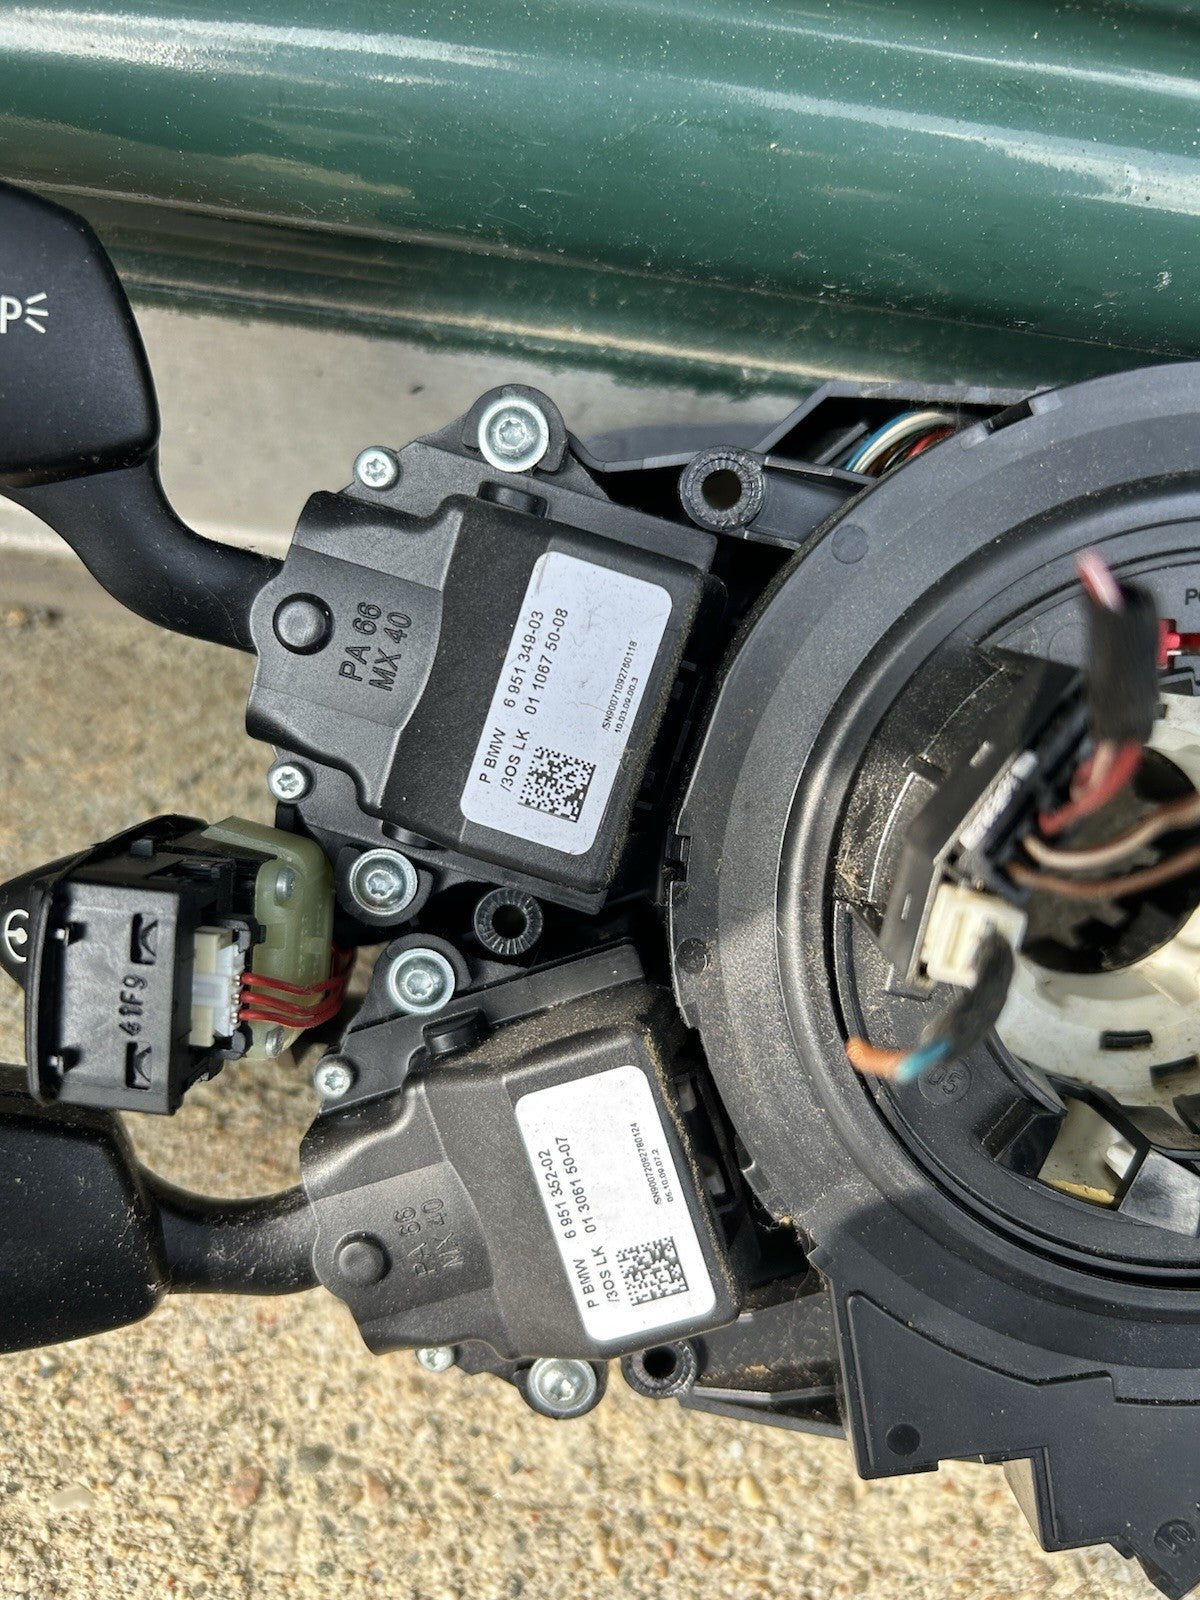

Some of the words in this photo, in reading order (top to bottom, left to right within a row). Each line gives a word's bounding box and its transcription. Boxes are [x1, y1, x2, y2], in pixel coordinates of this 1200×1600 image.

[1184, 588, 1200, 606] P
[352, 602, 382, 635] 66
[383, 611, 412, 645] 40
[545, 607, 568, 652] 50-08
[517, 610, 544, 663] 349-03
[338, 646, 371, 682] PA
[368, 647, 402, 692] MX
[507, 665, 526, 694] 951
[532, 654, 553, 691] 1067
[503, 698, 516, 708] 6
[524, 696, 541, 715] 01
[483, 727, 506, 769] BMW
[512, 728, 530, 751] LK
[478, 772, 491, 784] P
[554, 1136, 578, 1175] 50-07
[538, 1148, 563, 1197] 352-02
[569, 1178, 590, 1213] 3061
[393, 1206, 421, 1237] 66
[555, 1200, 573, 1227] 951
[582, 1216, 597, 1234] 01
[564, 1229, 577, 1239] 6
[591, 1245, 607, 1267] LK
[572, 1259, 595, 1295] BMW
[586, 1299, 600, 1309] P
